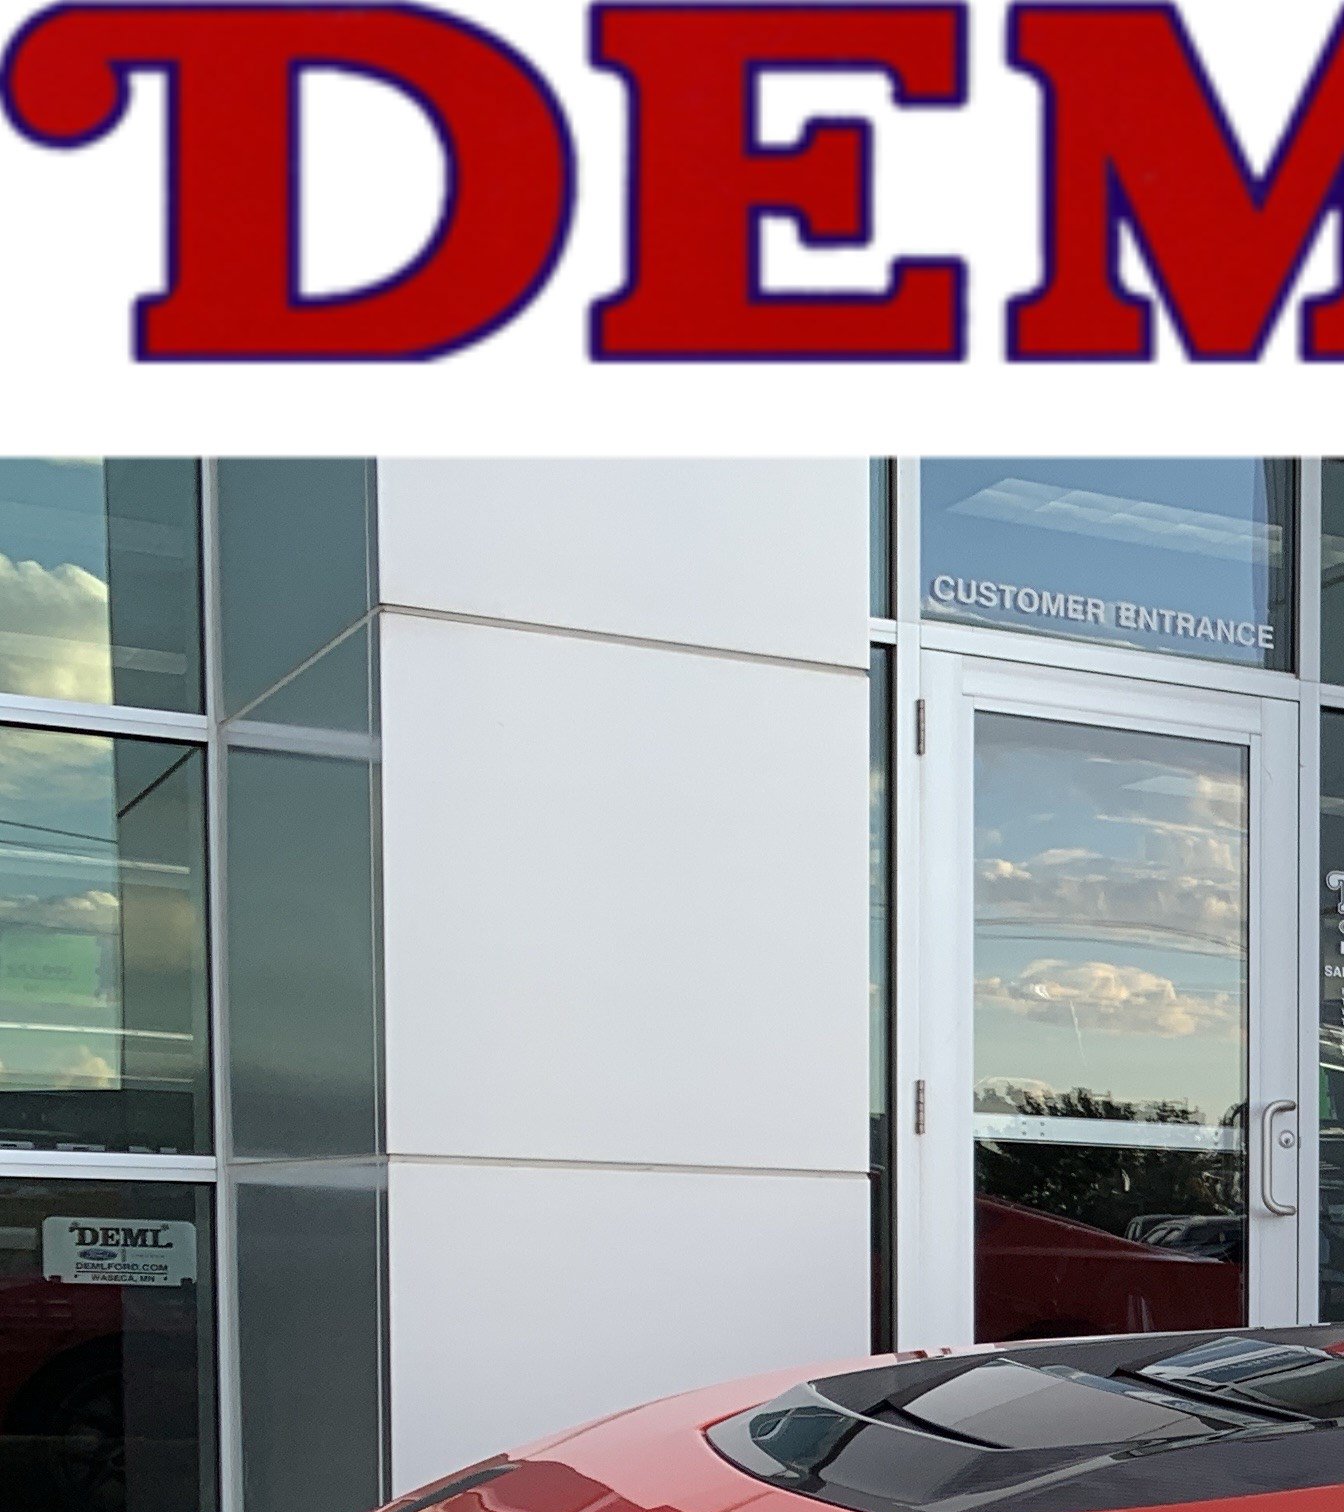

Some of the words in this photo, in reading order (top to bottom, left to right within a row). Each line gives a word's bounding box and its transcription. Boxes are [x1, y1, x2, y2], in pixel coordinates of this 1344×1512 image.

[933, 575, 1106, 624] CUSTOMER
[1116, 601, 1275, 650] ENTRANCE
[68, 1227, 173, 1248] DEML
